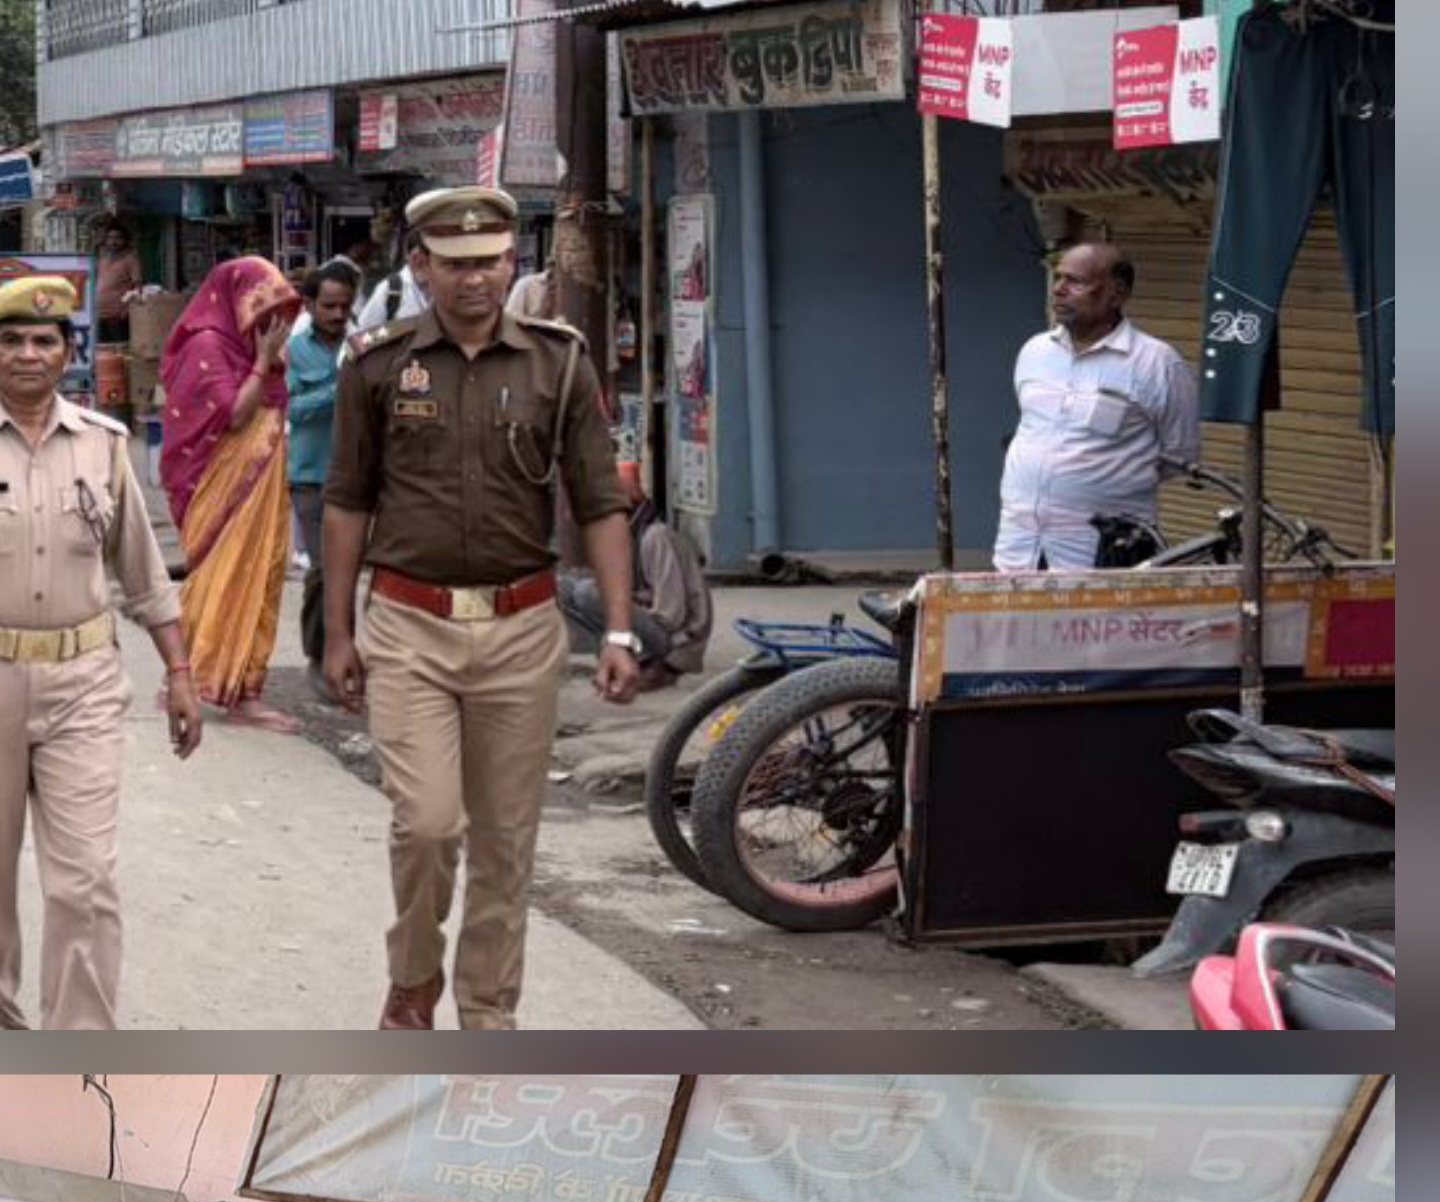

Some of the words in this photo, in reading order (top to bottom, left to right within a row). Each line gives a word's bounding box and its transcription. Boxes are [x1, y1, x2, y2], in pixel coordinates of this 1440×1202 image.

[727, 24, 798, 105] बुक
[977, 43, 1011, 67] MNP
[1179, 45, 1217, 75] MNP
[1053, 619, 1124, 645] MNP
